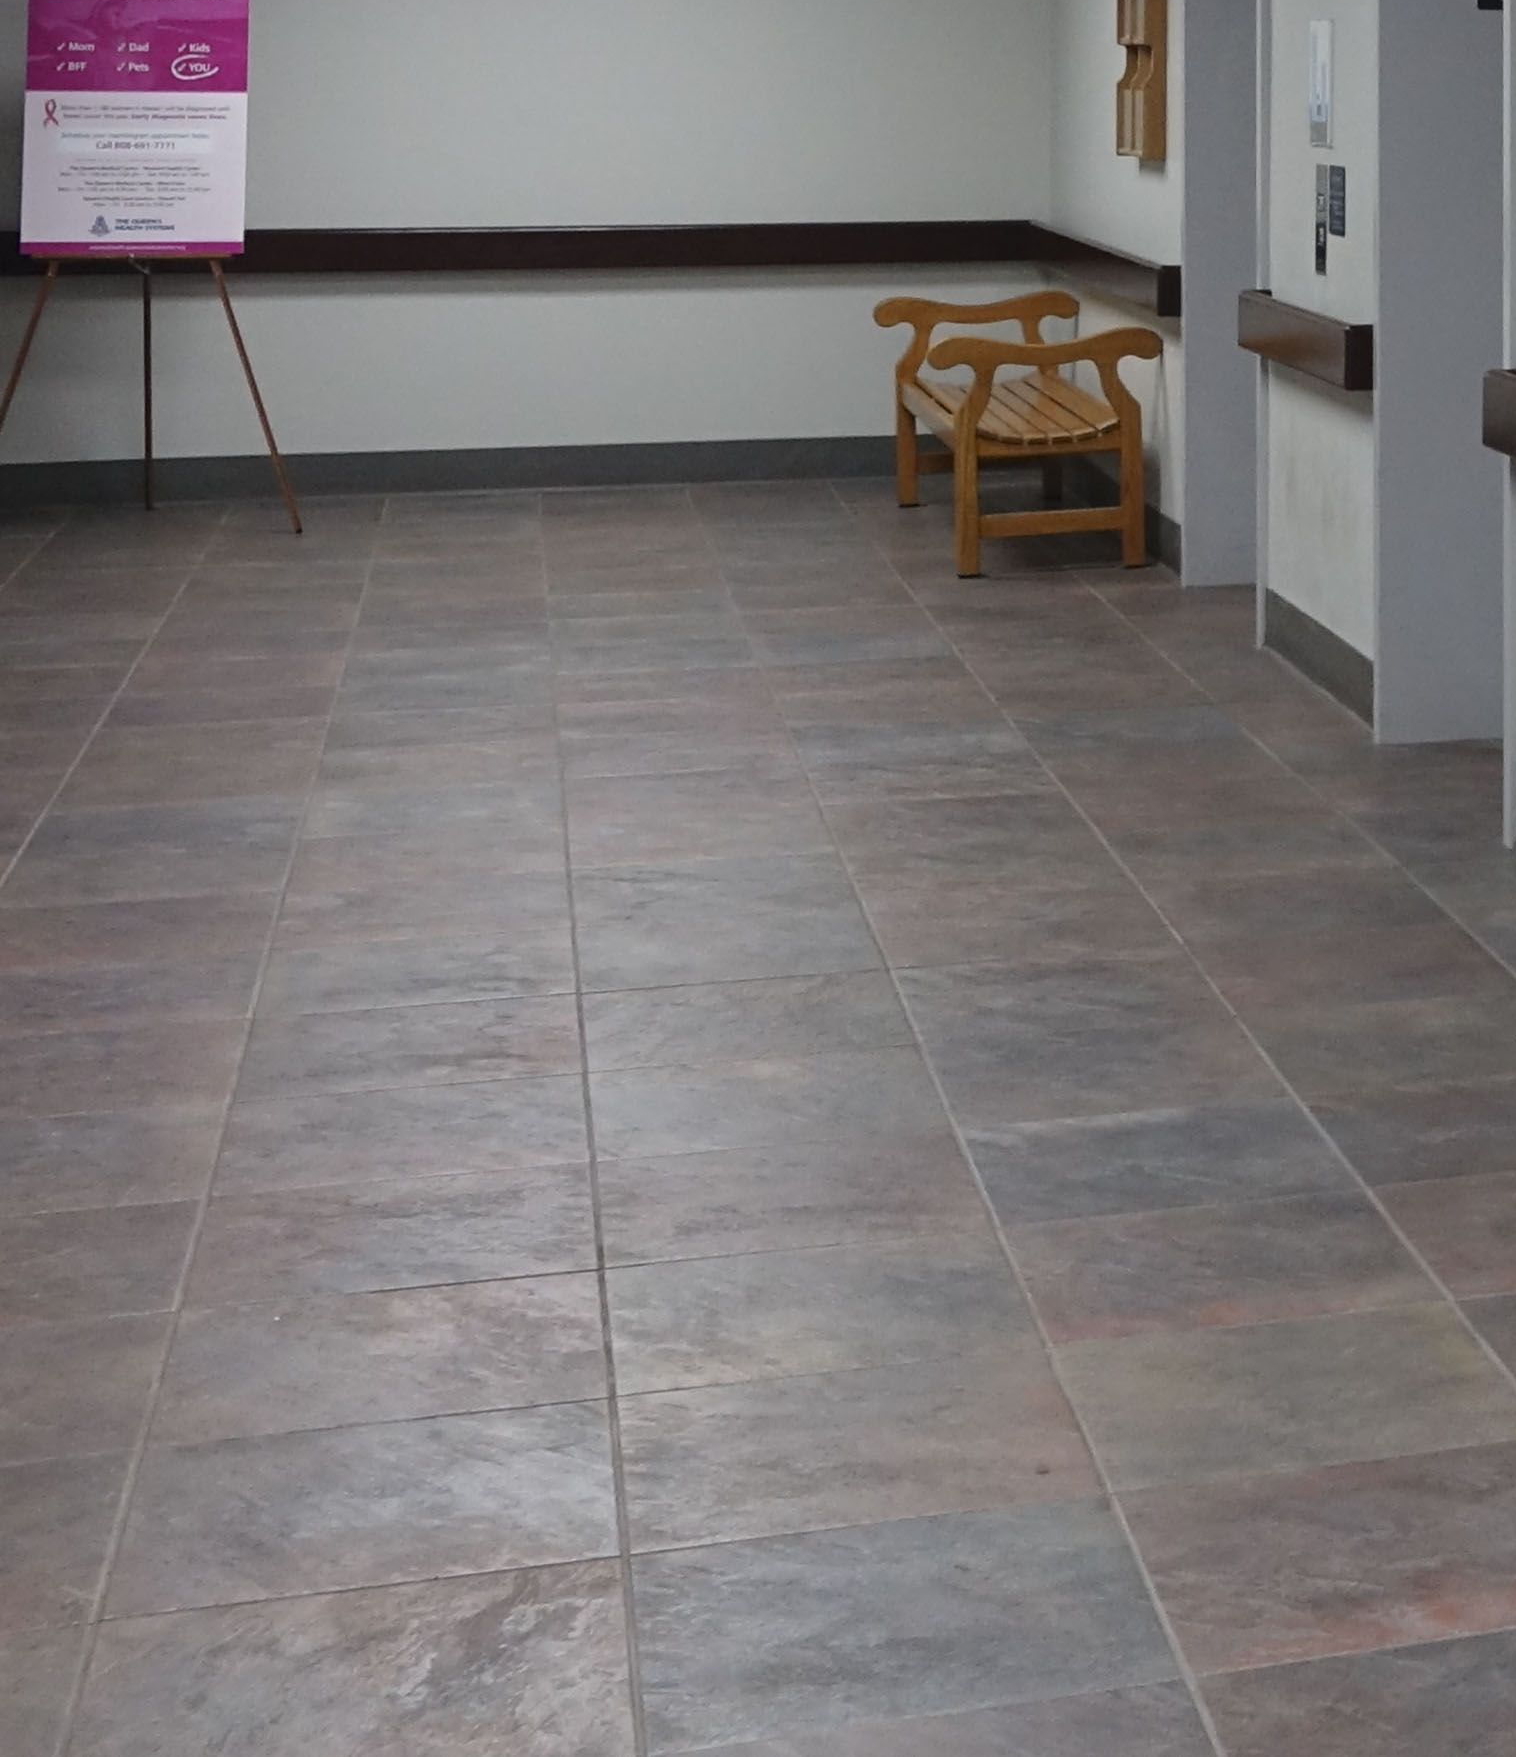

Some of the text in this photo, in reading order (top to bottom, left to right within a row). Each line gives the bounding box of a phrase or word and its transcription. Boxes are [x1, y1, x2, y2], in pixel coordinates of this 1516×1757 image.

[69, 42, 210, 53] Mom Dad Kids
[189, 63, 210, 72] YOU
[96, 141, 112, 150] Call
